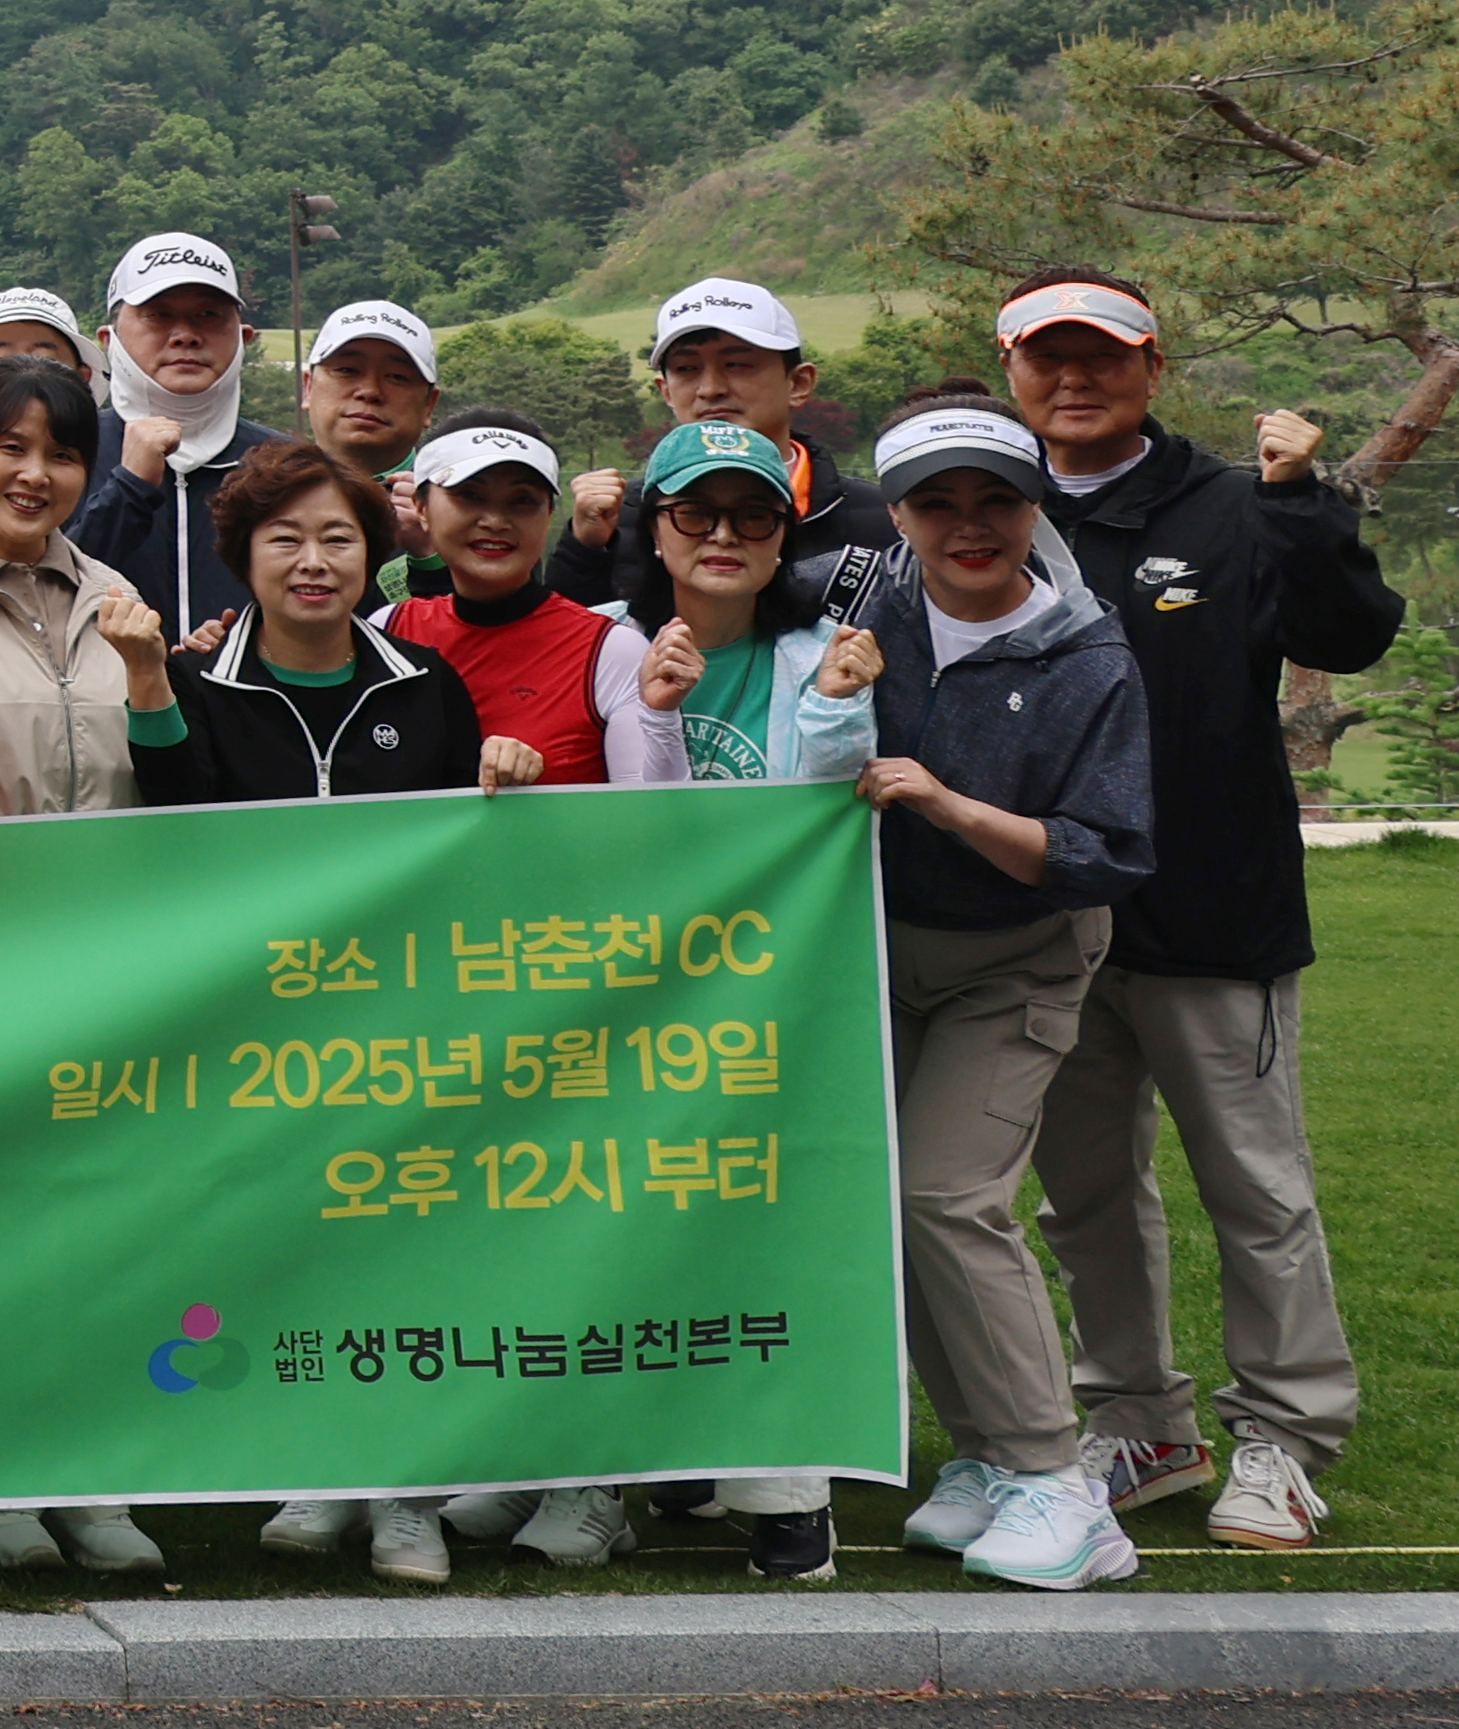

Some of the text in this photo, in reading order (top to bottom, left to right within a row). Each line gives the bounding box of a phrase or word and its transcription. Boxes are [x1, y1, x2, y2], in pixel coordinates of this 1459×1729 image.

[137, 247, 228, 276] Titleist
[471, 430, 529, 450] Callaway
[267, 938, 379, 998] 장소
[451, 913, 662, 993] 남춘천
[679, 910, 775, 977] CC
[49, 1057, 159, 1119] 일시
[229, 1033, 483, 1109] 2025년
[503, 1027, 610, 1099] 5월
[626, 1020, 779, 1095] 19일
[321, 1133, 778, 1219] 오후 12시 부터
[273, 1330, 323, 1355] 사단
[336, 1311, 790, 1383] 생명나눔실천본부
[275, 1357, 324, 1382] 법인
